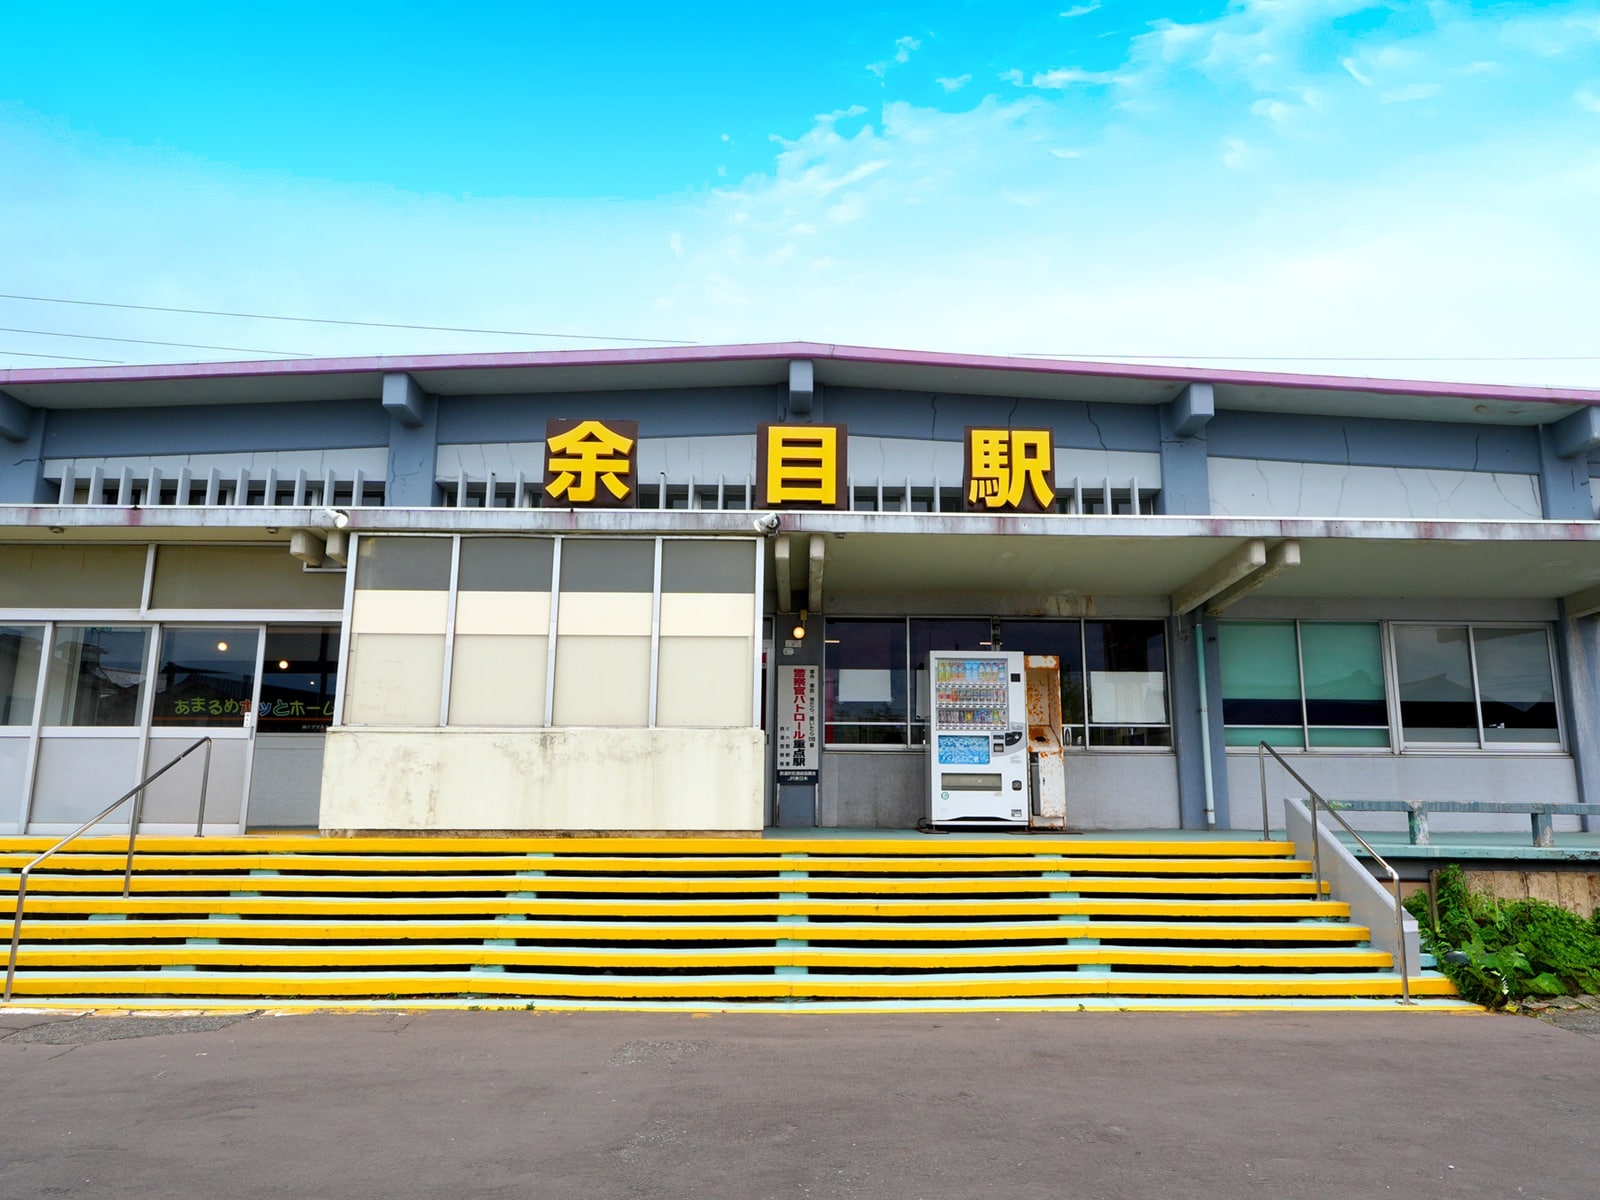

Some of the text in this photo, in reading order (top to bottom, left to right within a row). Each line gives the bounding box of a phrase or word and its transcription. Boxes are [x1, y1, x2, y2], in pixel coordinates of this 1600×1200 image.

[545, 420, 1056, 509] 余目駅
[793, 668, 806, 767] 警察官パトロール重点駅
